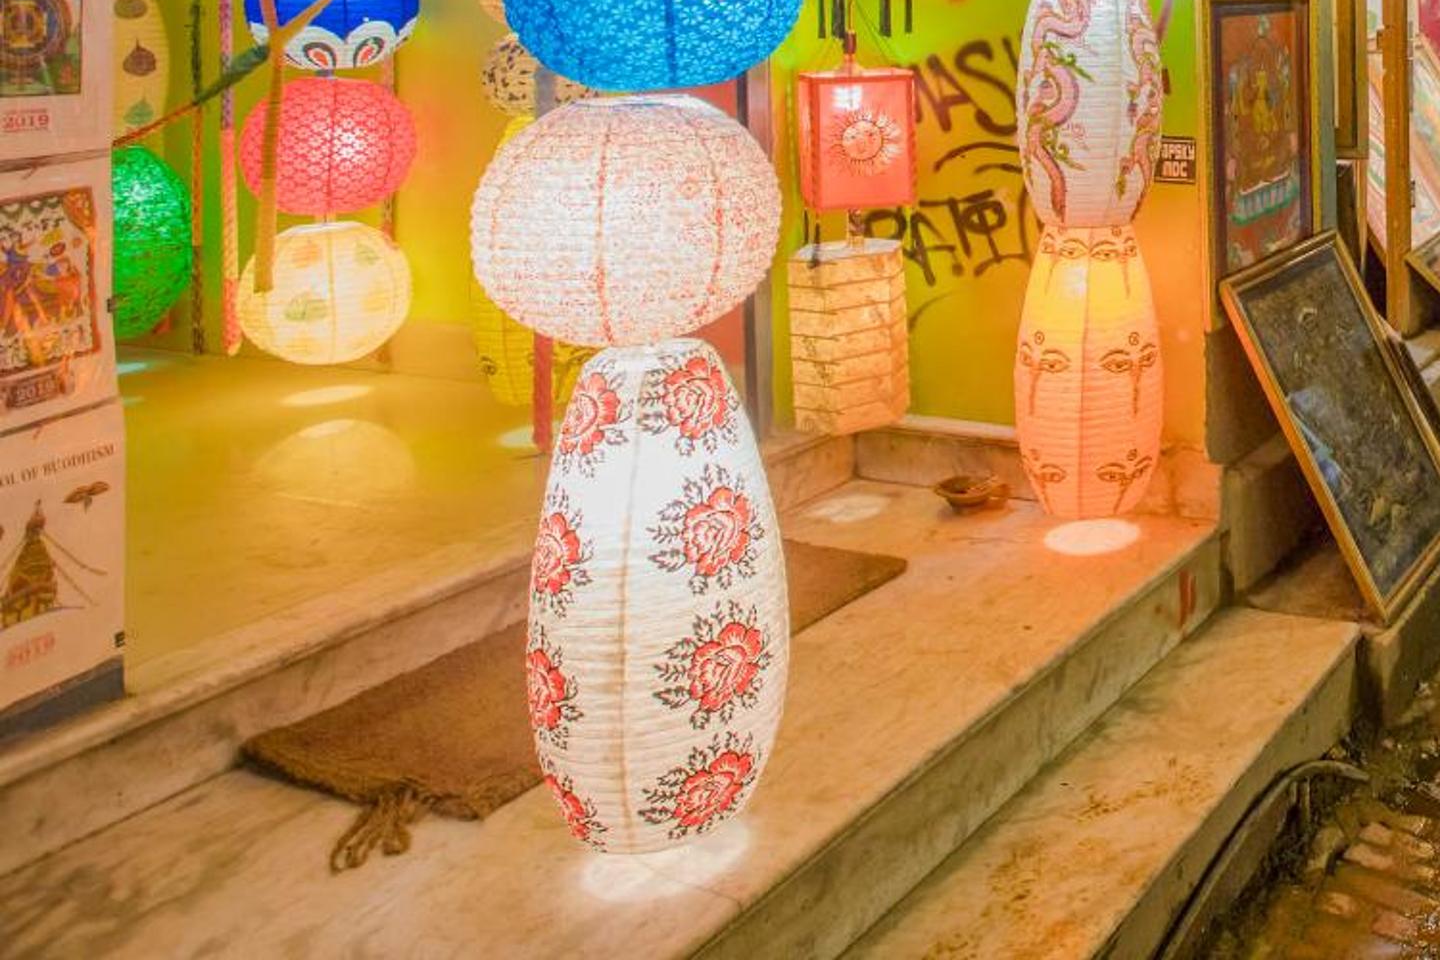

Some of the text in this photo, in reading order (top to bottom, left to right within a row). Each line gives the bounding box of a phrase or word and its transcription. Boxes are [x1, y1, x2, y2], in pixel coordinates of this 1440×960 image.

[4, 113, 50, 130] 2019
[20, 466, 40, 483] OF
[43, 442, 115, 477] BUDDHISM
